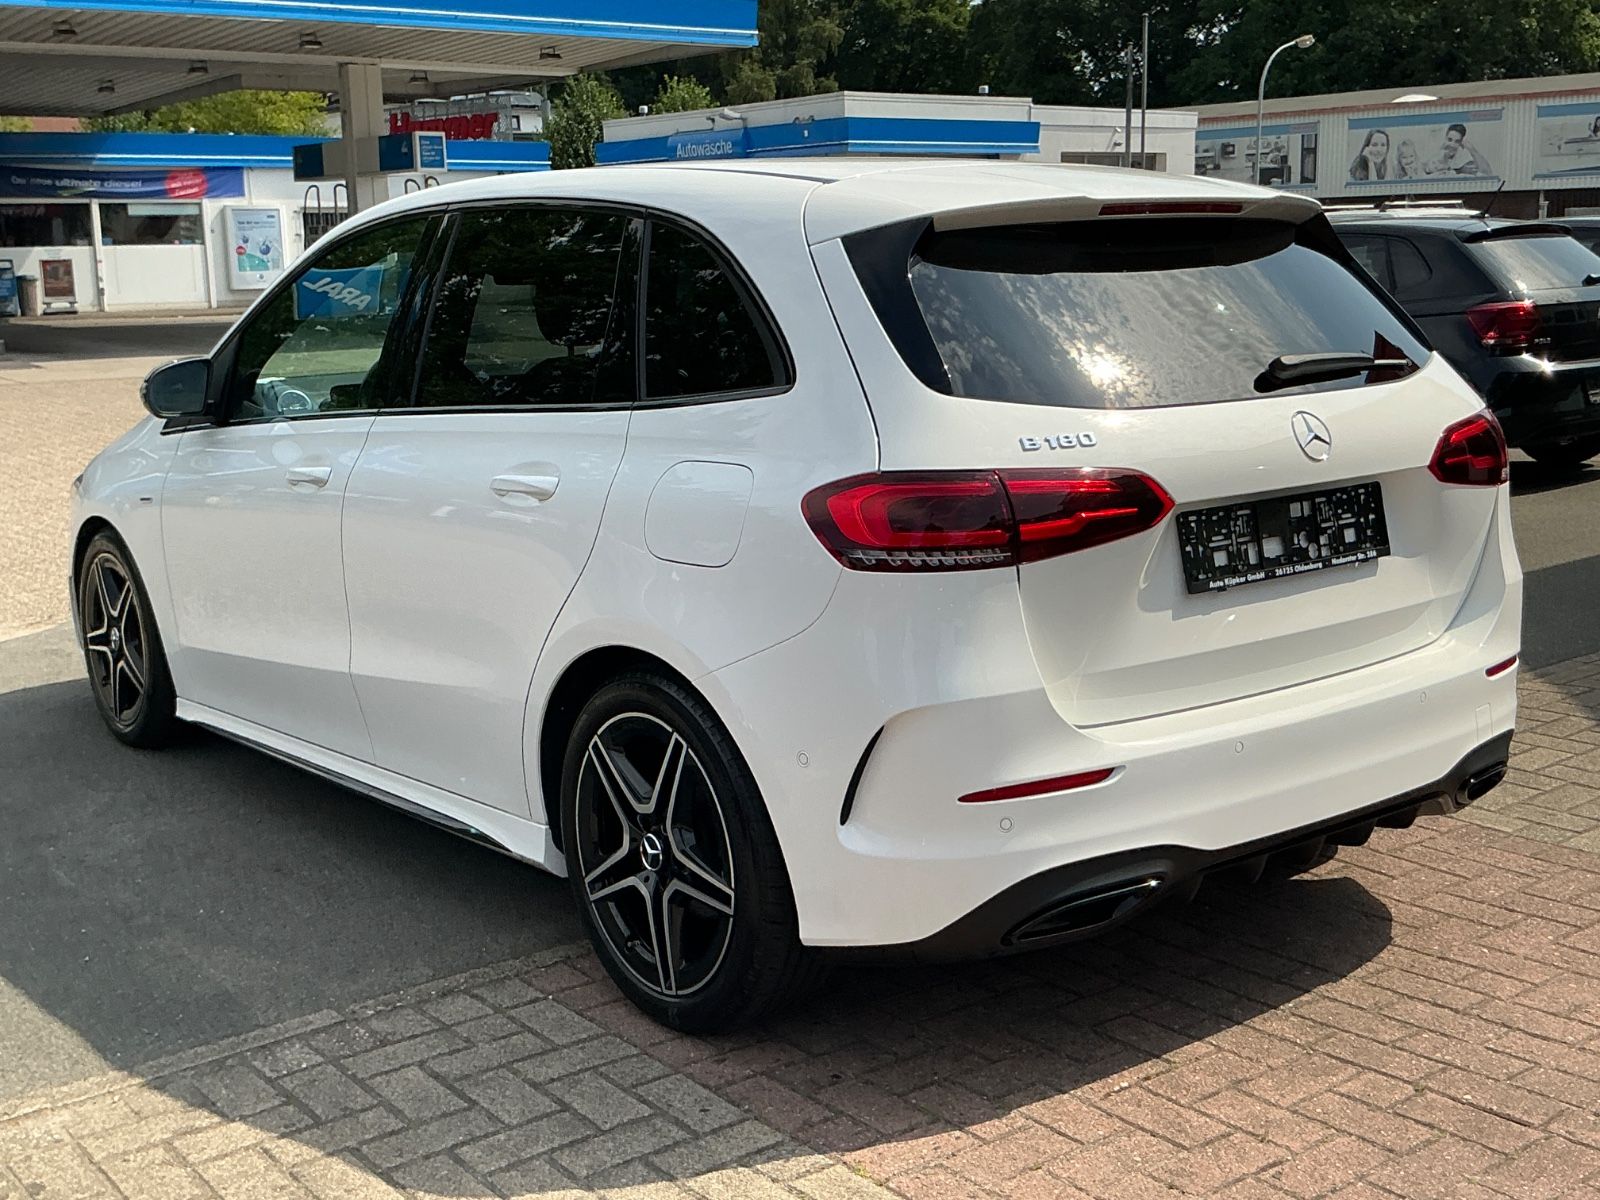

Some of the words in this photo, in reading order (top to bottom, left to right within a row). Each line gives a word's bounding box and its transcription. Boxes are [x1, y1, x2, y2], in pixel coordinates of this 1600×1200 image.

[390, 112, 498, 139] Hammer
[676, 139, 733, 158] Autowäsche
[55, 178, 102, 188] ultimate
[103, 179, 143, 188] diesel
[1019, 437, 1041, 452] B
[1044, 432, 1097, 450] 180
[1209, 580, 1224, 589] Auto
[1246, 572, 1265, 582] GmbH
[1274, 566, 1294, 577] 26125
[1294, 561, 1323, 573] Oldenburg
